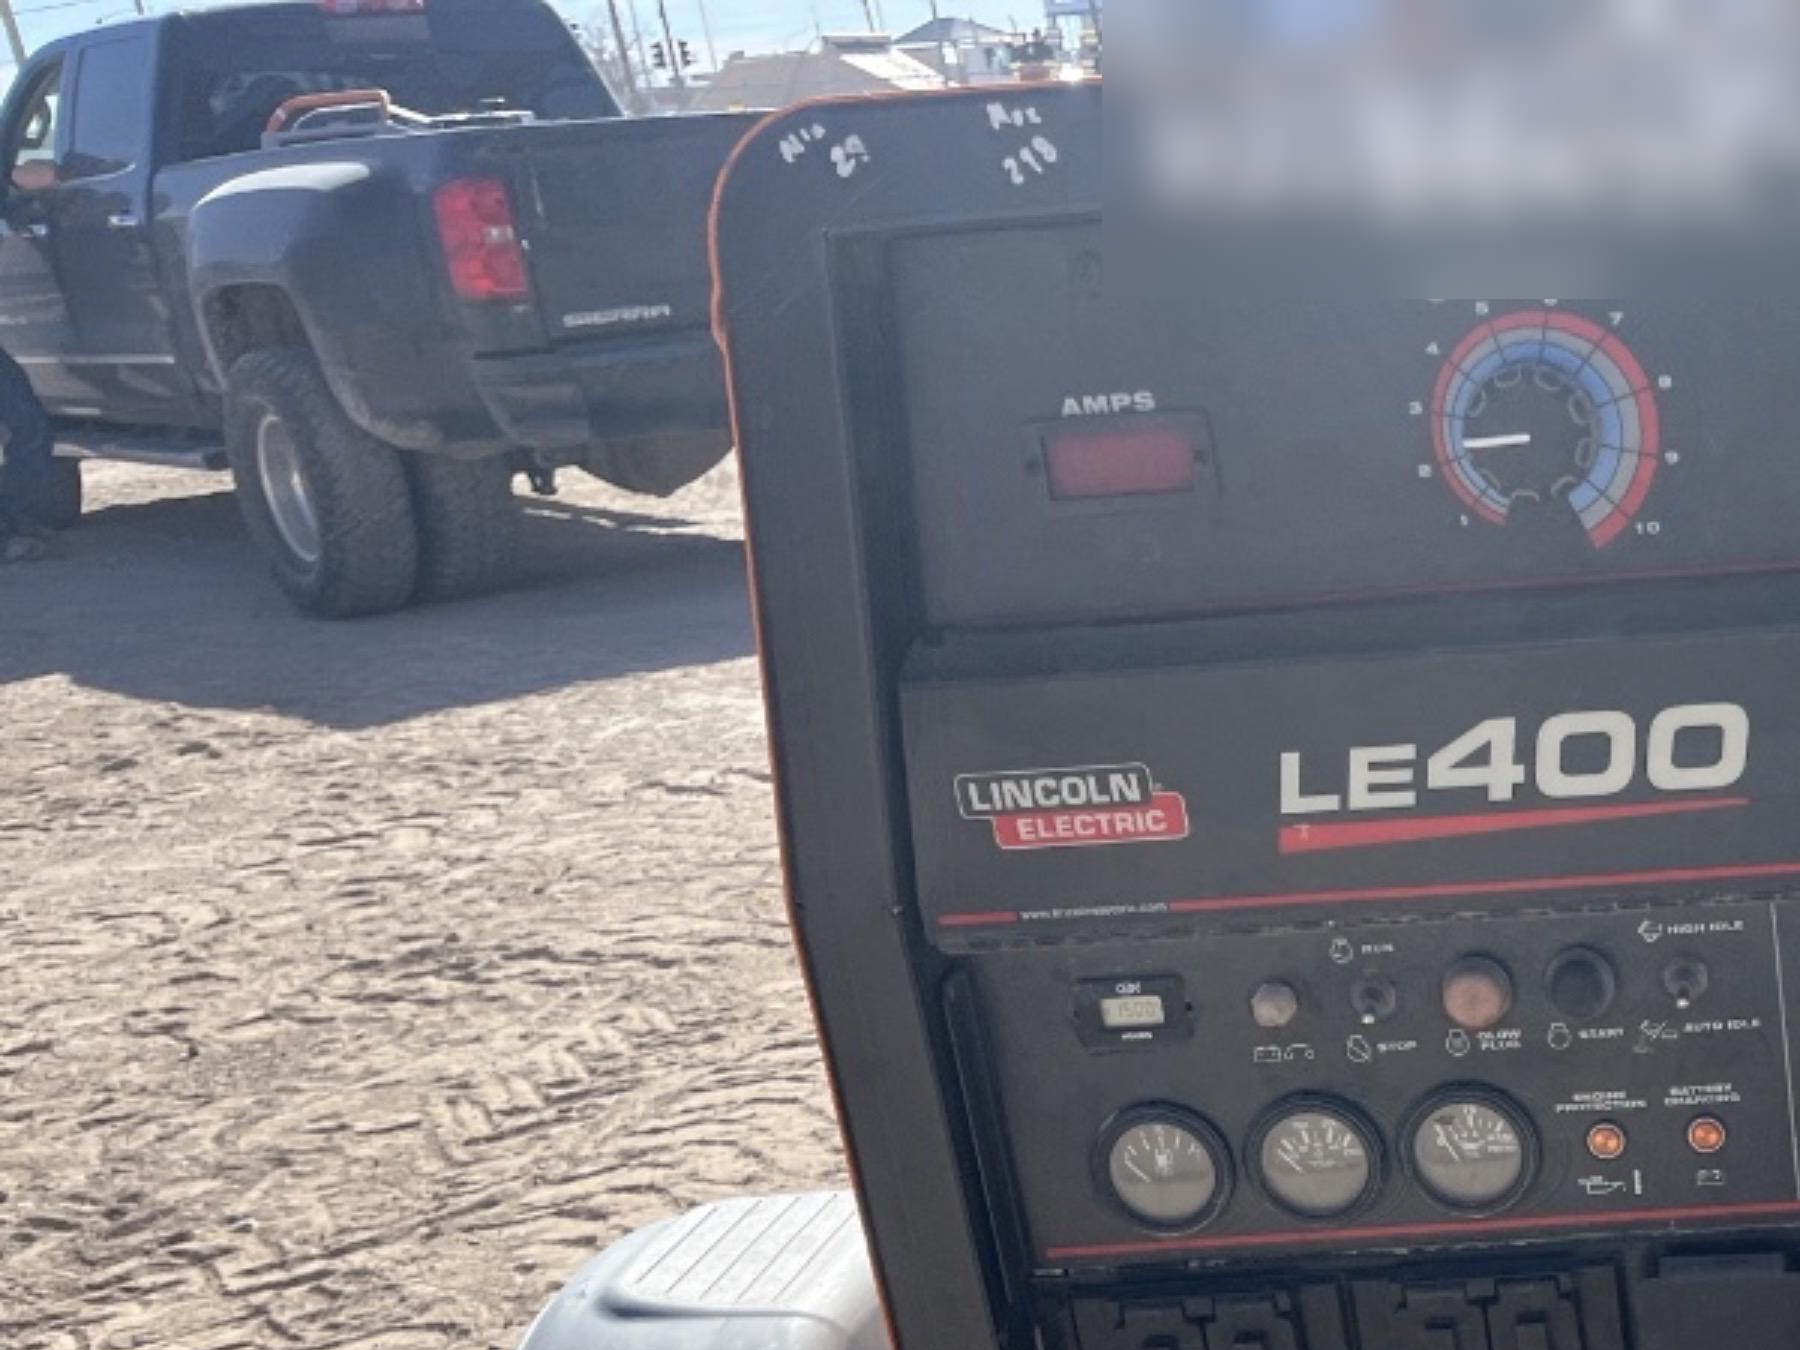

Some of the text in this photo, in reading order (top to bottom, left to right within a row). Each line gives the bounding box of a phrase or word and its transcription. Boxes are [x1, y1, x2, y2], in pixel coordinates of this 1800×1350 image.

[1060, 391, 1156, 416] AMPS
[1280, 702, 1749, 814] LE400
[968, 772, 1141, 811] LINCOLN
[1016, 809, 1167, 841] ELECTRIC
